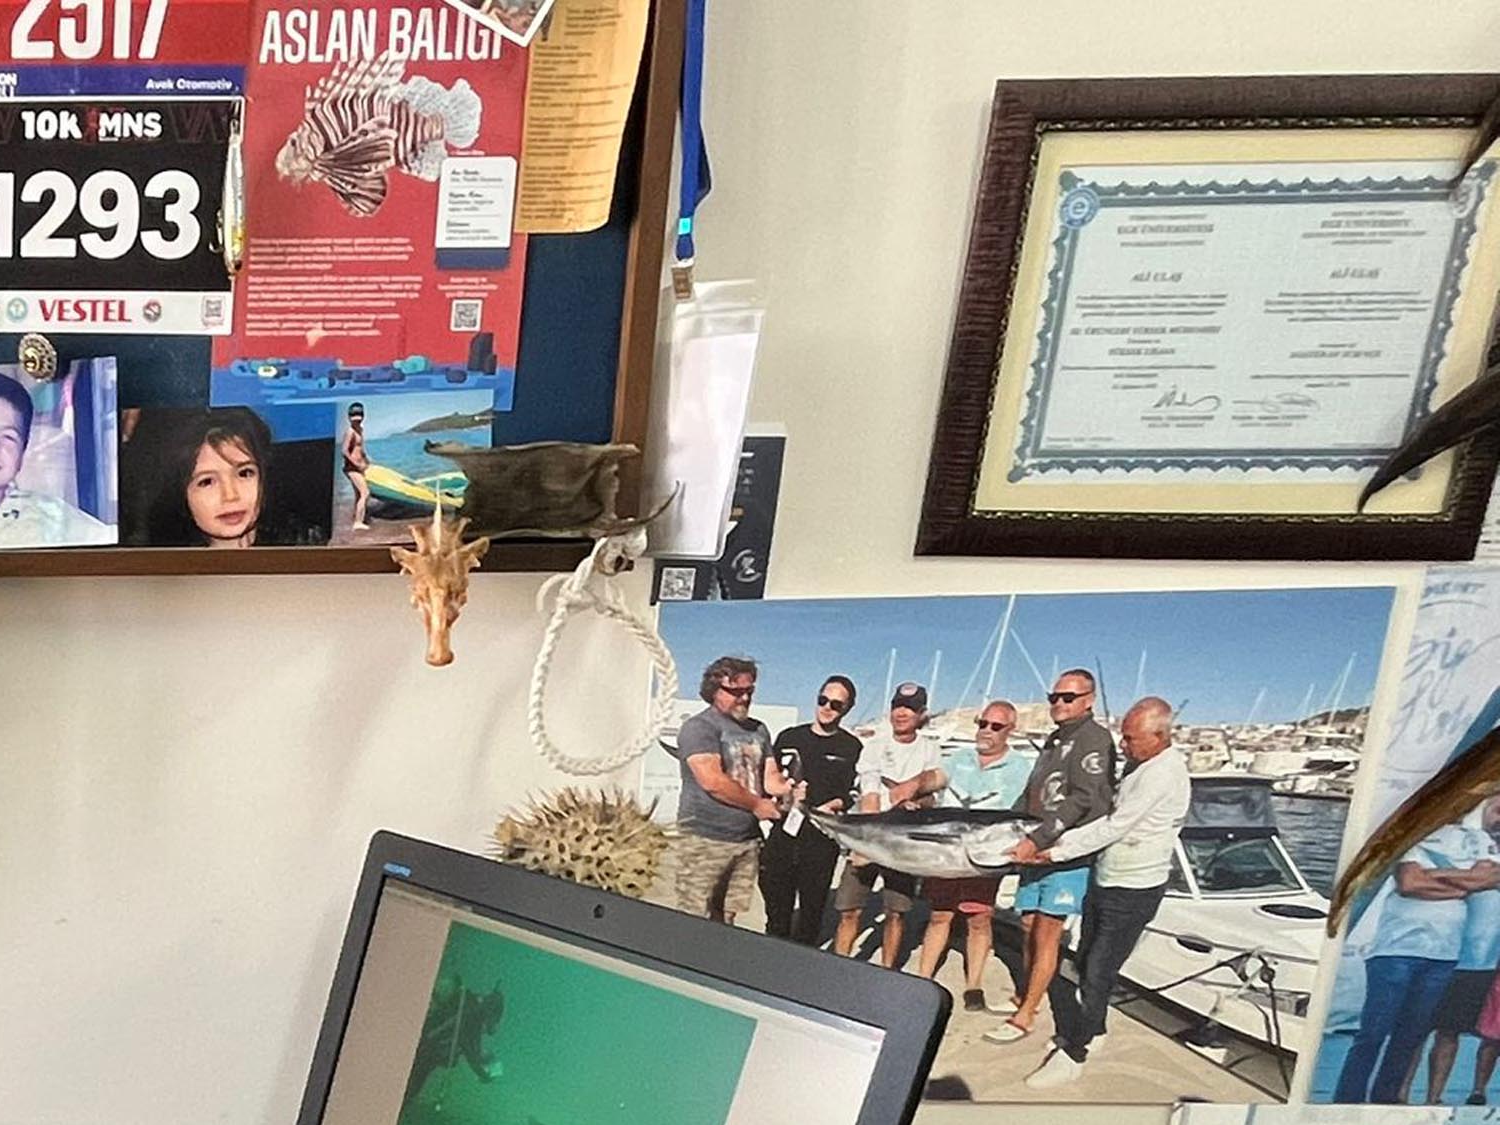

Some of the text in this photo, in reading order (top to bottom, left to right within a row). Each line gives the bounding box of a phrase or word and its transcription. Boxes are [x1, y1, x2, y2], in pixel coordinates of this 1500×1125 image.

[258, 7, 378, 64] ASLAN
[98, 113, 162, 142] MNS
[38, 299, 132, 323] VESTEL
